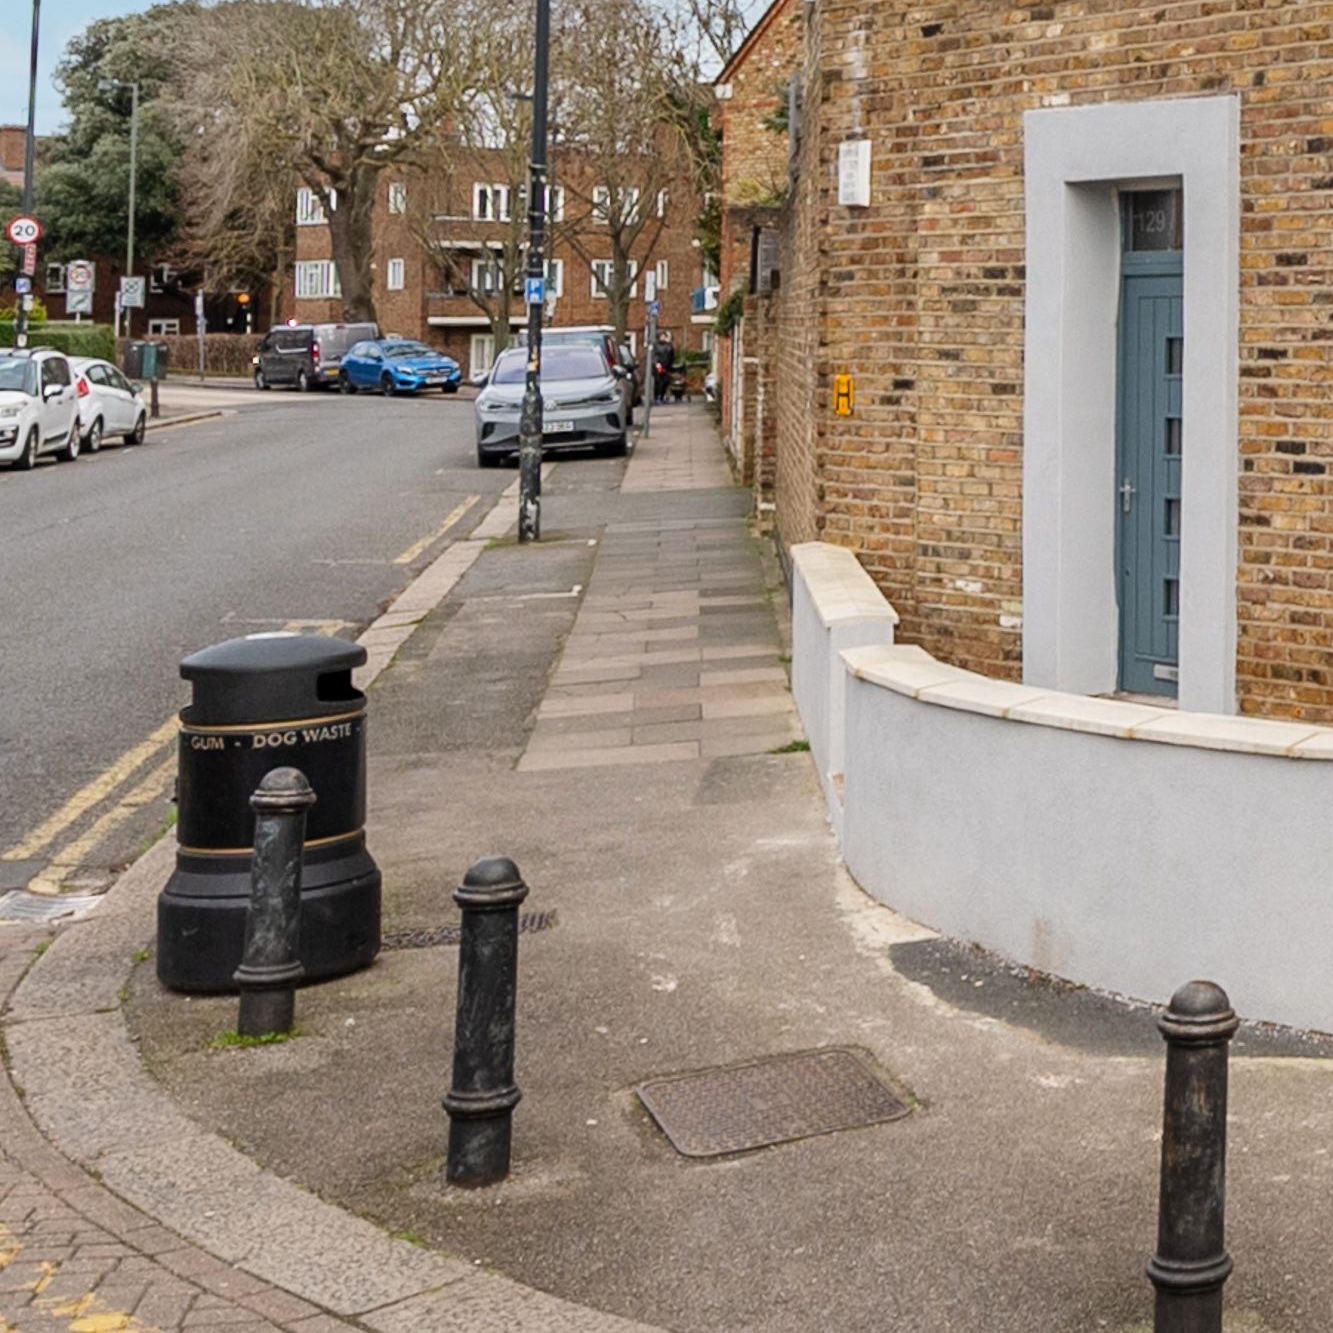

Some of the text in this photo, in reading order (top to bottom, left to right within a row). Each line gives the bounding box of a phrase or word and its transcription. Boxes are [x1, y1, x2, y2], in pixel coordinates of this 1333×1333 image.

[14, 225, 35, 237] 20
[1139, 210, 1166, 233] 129
[191, 722, 352, 750] GUM DOG WASTE
